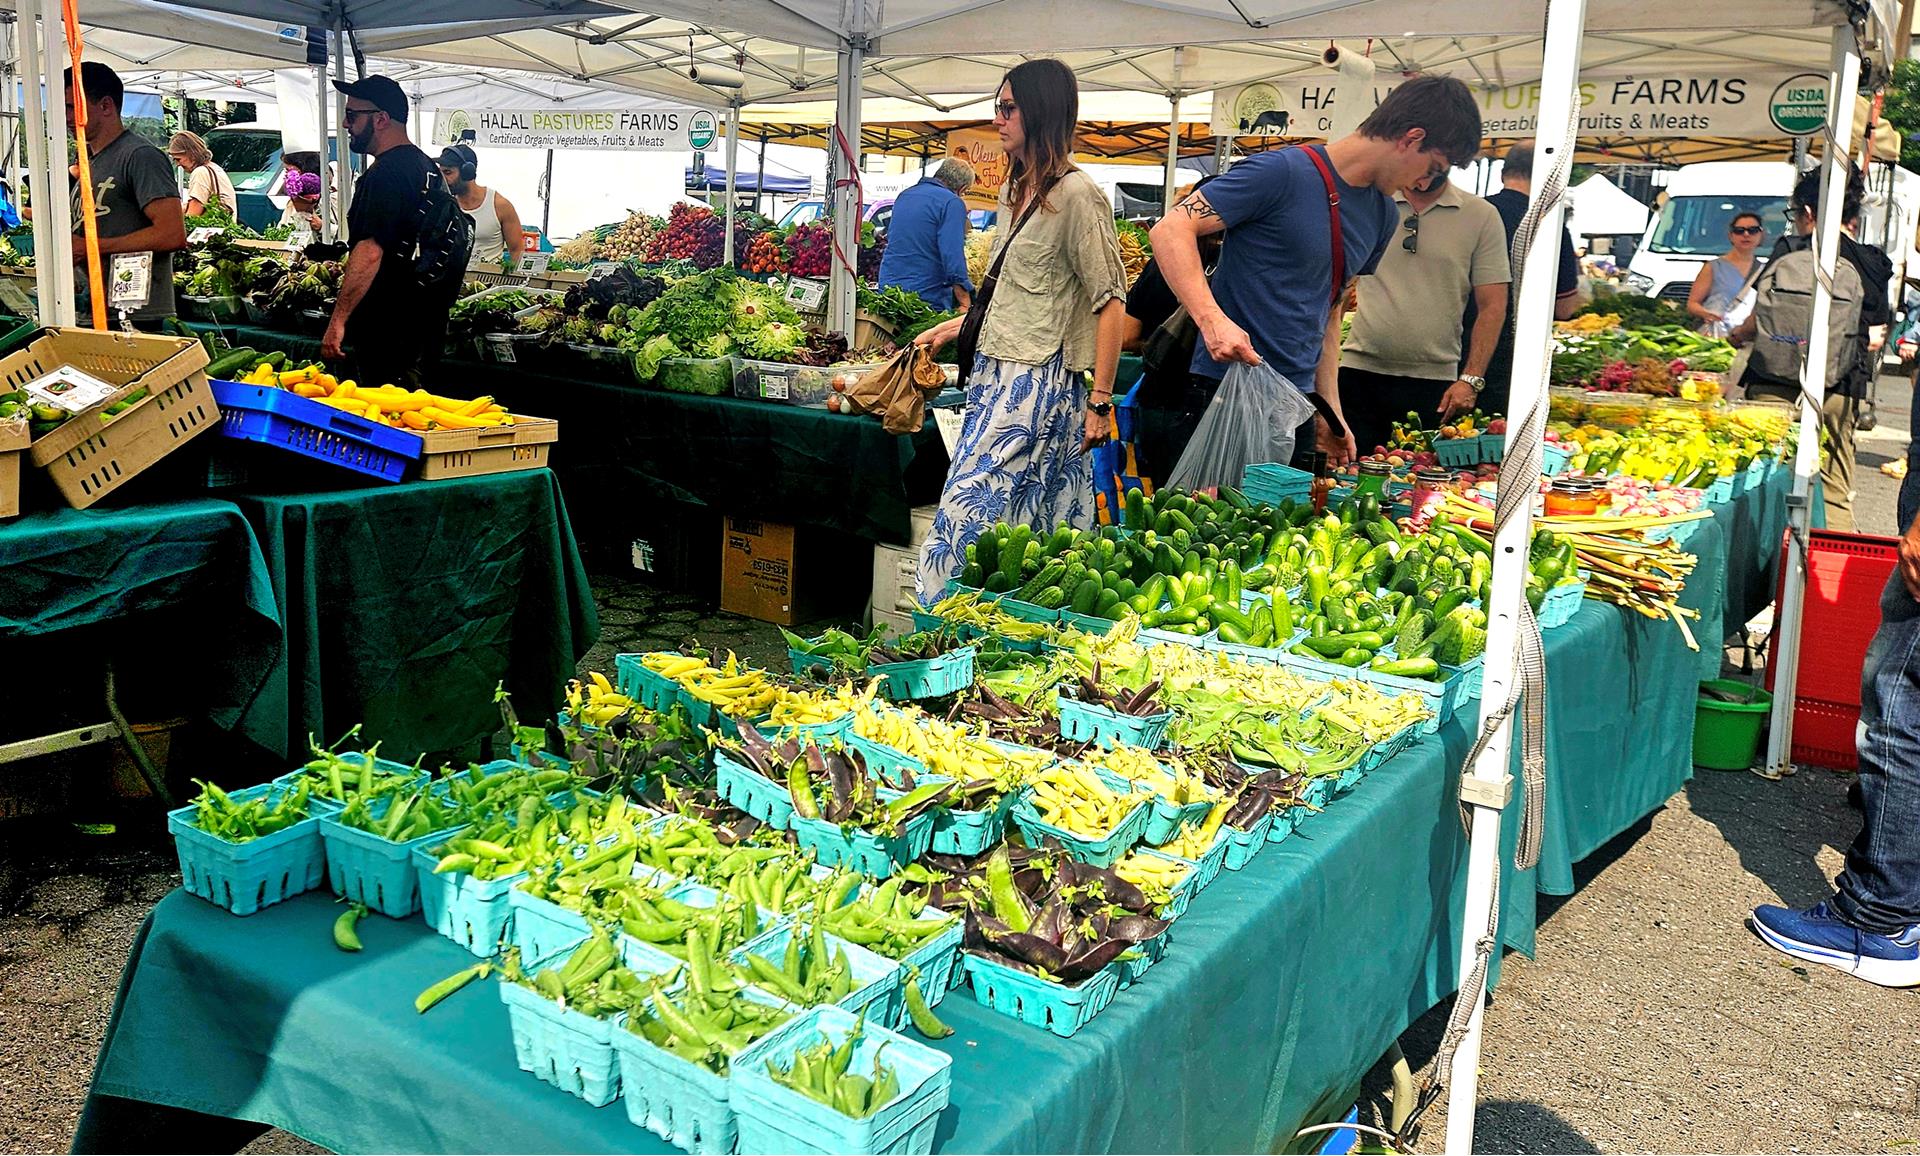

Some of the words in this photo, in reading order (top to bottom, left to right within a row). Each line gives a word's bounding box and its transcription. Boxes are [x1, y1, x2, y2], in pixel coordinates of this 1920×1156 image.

[1611, 78, 1747, 105] FARMS
[1787, 88, 1825, 102] USDA
[480, 113, 529, 130] HALAL
[533, 113, 614, 131] PASTURES
[620, 113, 679, 131] FARMS
[695, 120, 710, 129] USDA
[1578, 112, 1622, 130] ruits
[1629, 113, 1643, 130] &
[1650, 112, 1709, 130] Meats
[489, 132, 522, 145] Certified
[524, 133, 554, 147] Organic
[556, 134, 600, 148] Vegetables,
[601, 133, 627, 147] Fruits
[628, 135, 636, 147] &
[637, 134, 665, 147] Meats
